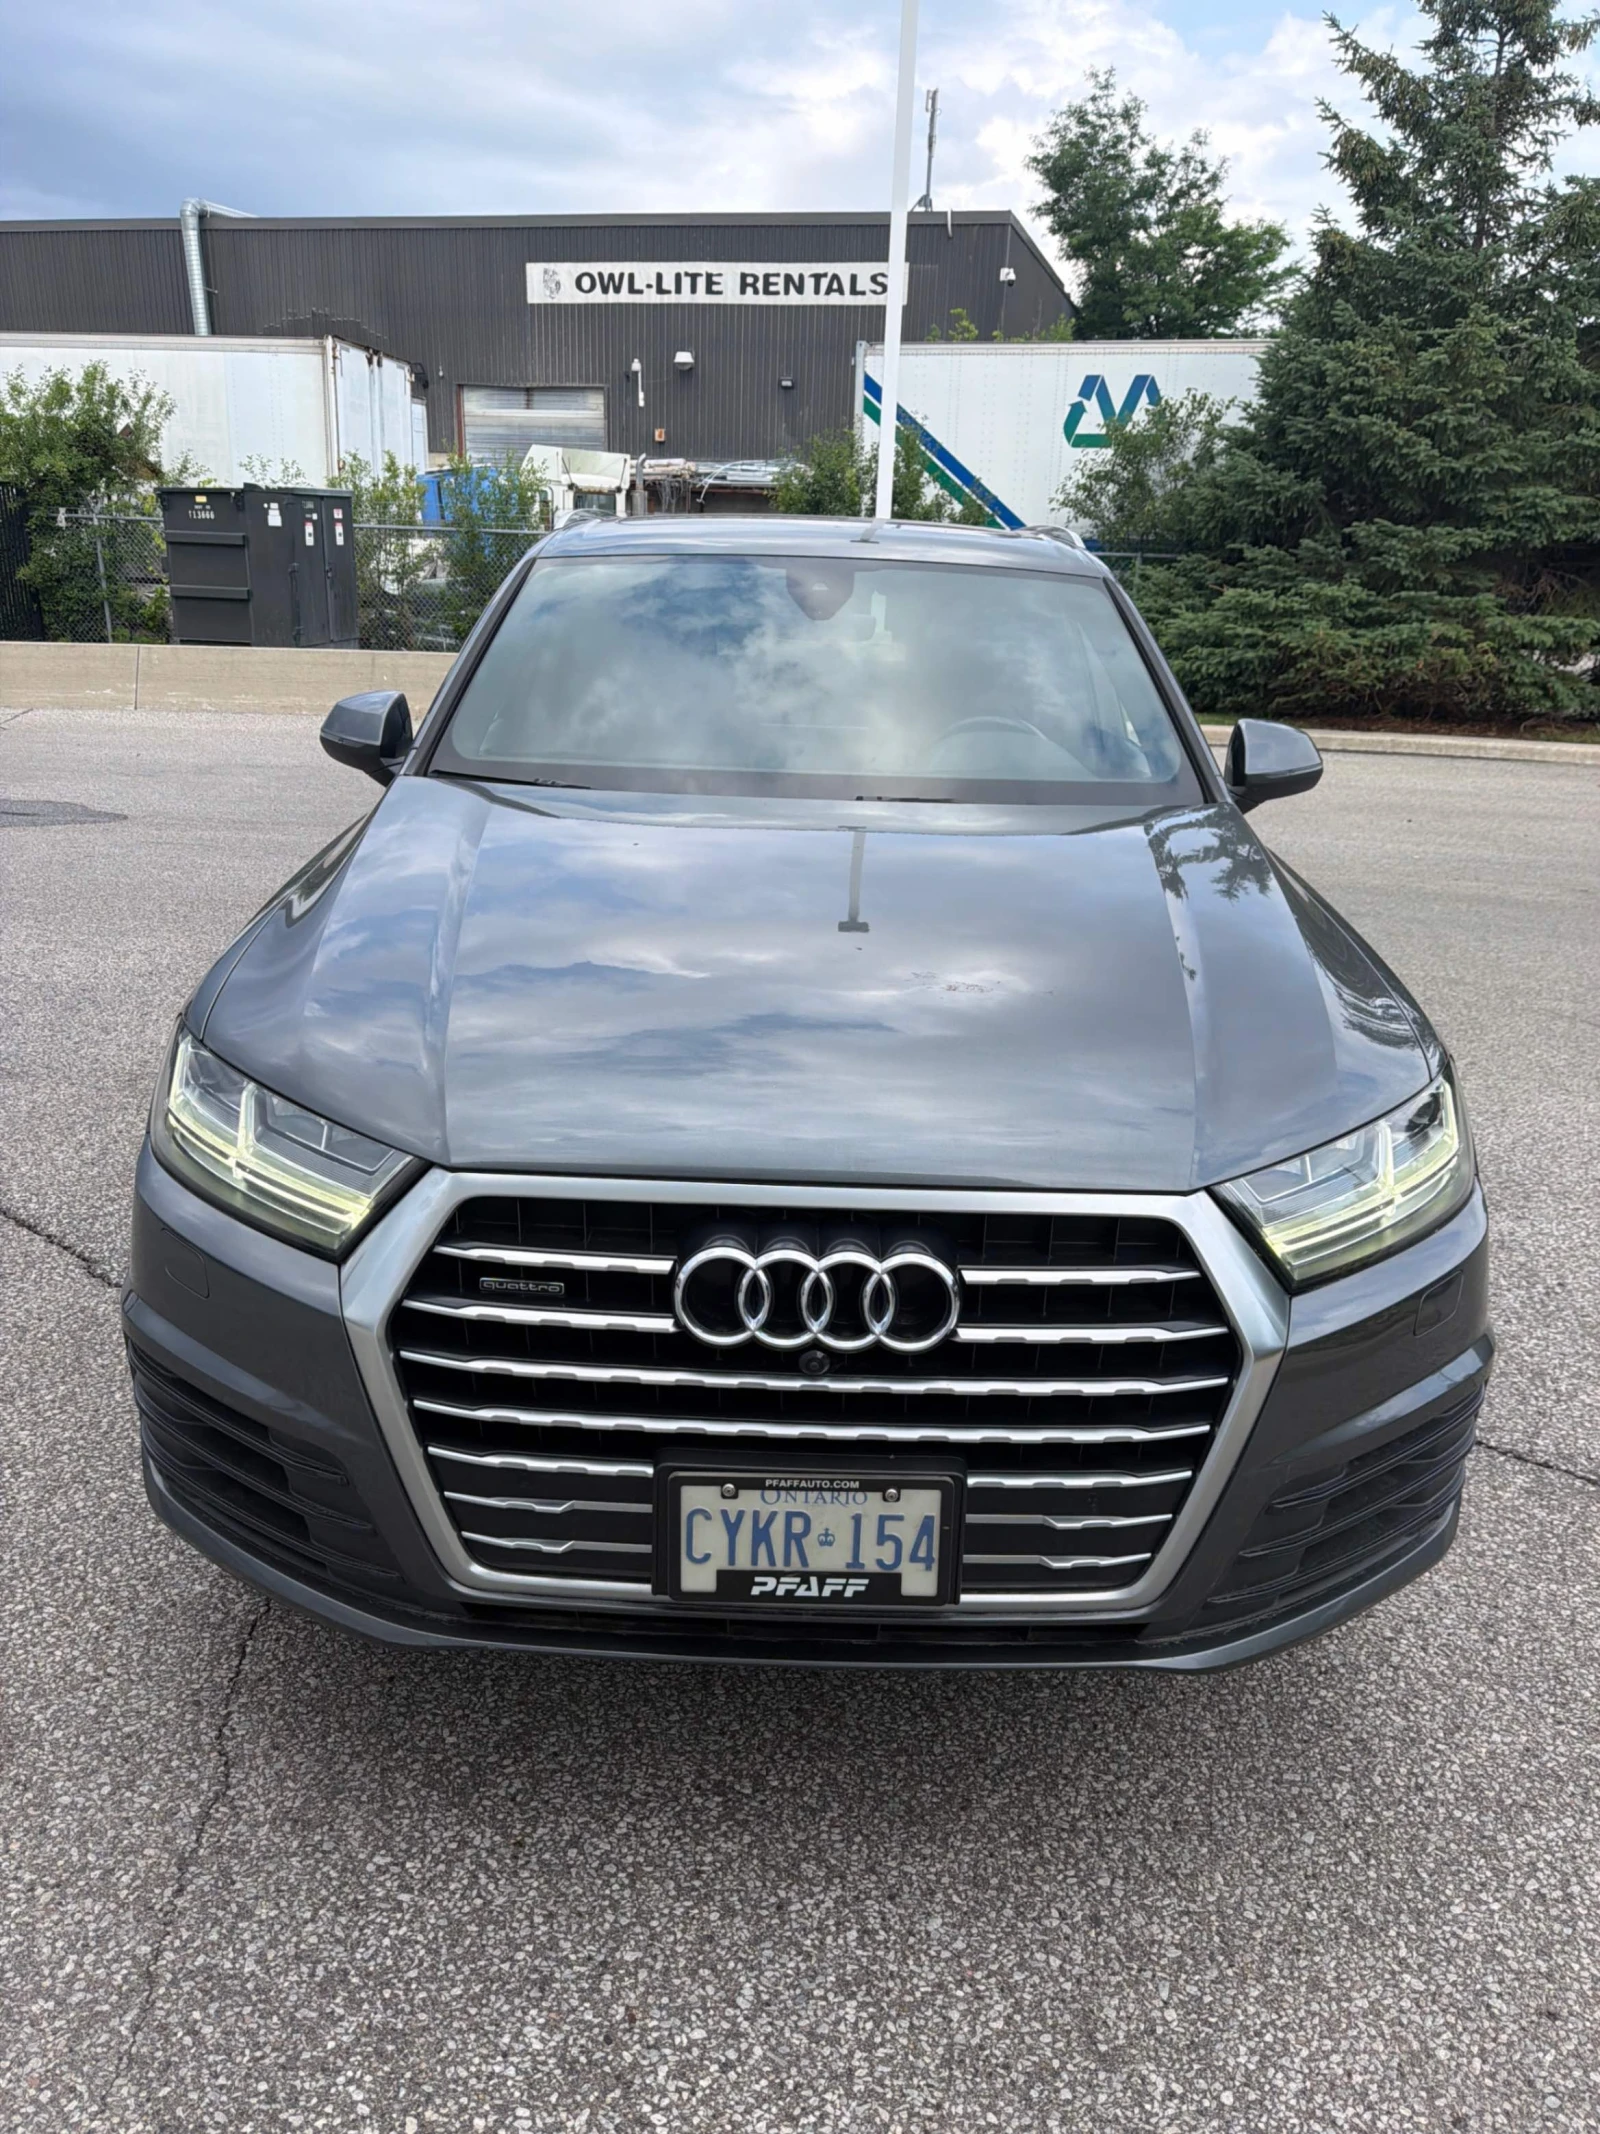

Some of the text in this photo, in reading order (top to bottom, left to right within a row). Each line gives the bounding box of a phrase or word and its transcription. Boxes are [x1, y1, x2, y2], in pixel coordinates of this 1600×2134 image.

[574, 271, 889, 296] OWL-LITE RENTALS
[483, 1281, 560, 1292] quattro
[765, 1478, 860, 1489] PFAFFAUTO.COM
[685, 1507, 937, 1572] CYKR 154
[750, 1576, 870, 1597] PFAFF
